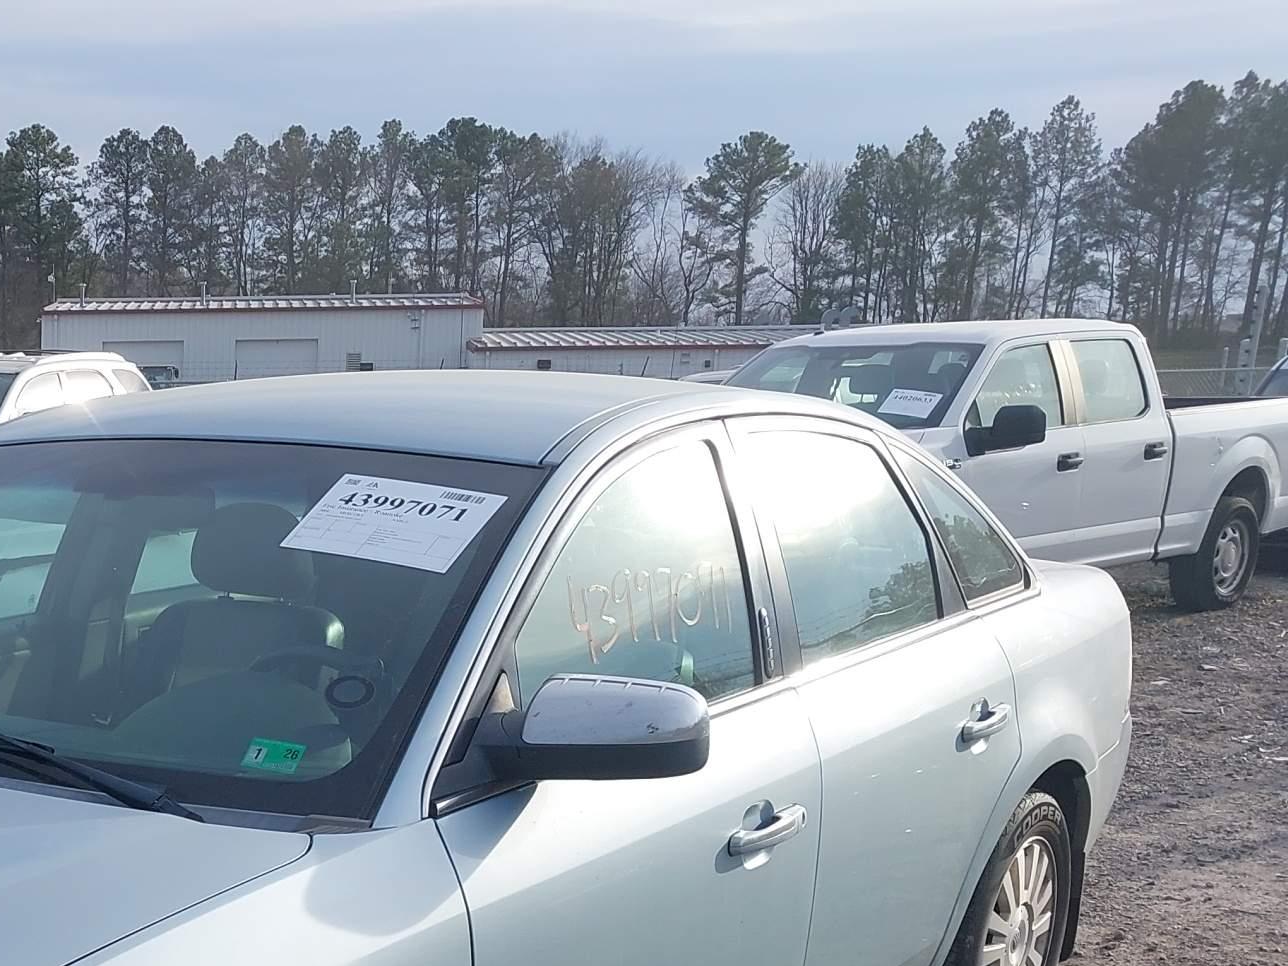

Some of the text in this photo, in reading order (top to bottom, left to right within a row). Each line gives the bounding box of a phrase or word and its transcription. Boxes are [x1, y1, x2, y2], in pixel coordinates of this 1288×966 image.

[339, 492, 468, 521] 43997071
[254, 747, 300, 760] 1 26
[1014, 805, 1062, 849] COOPER
